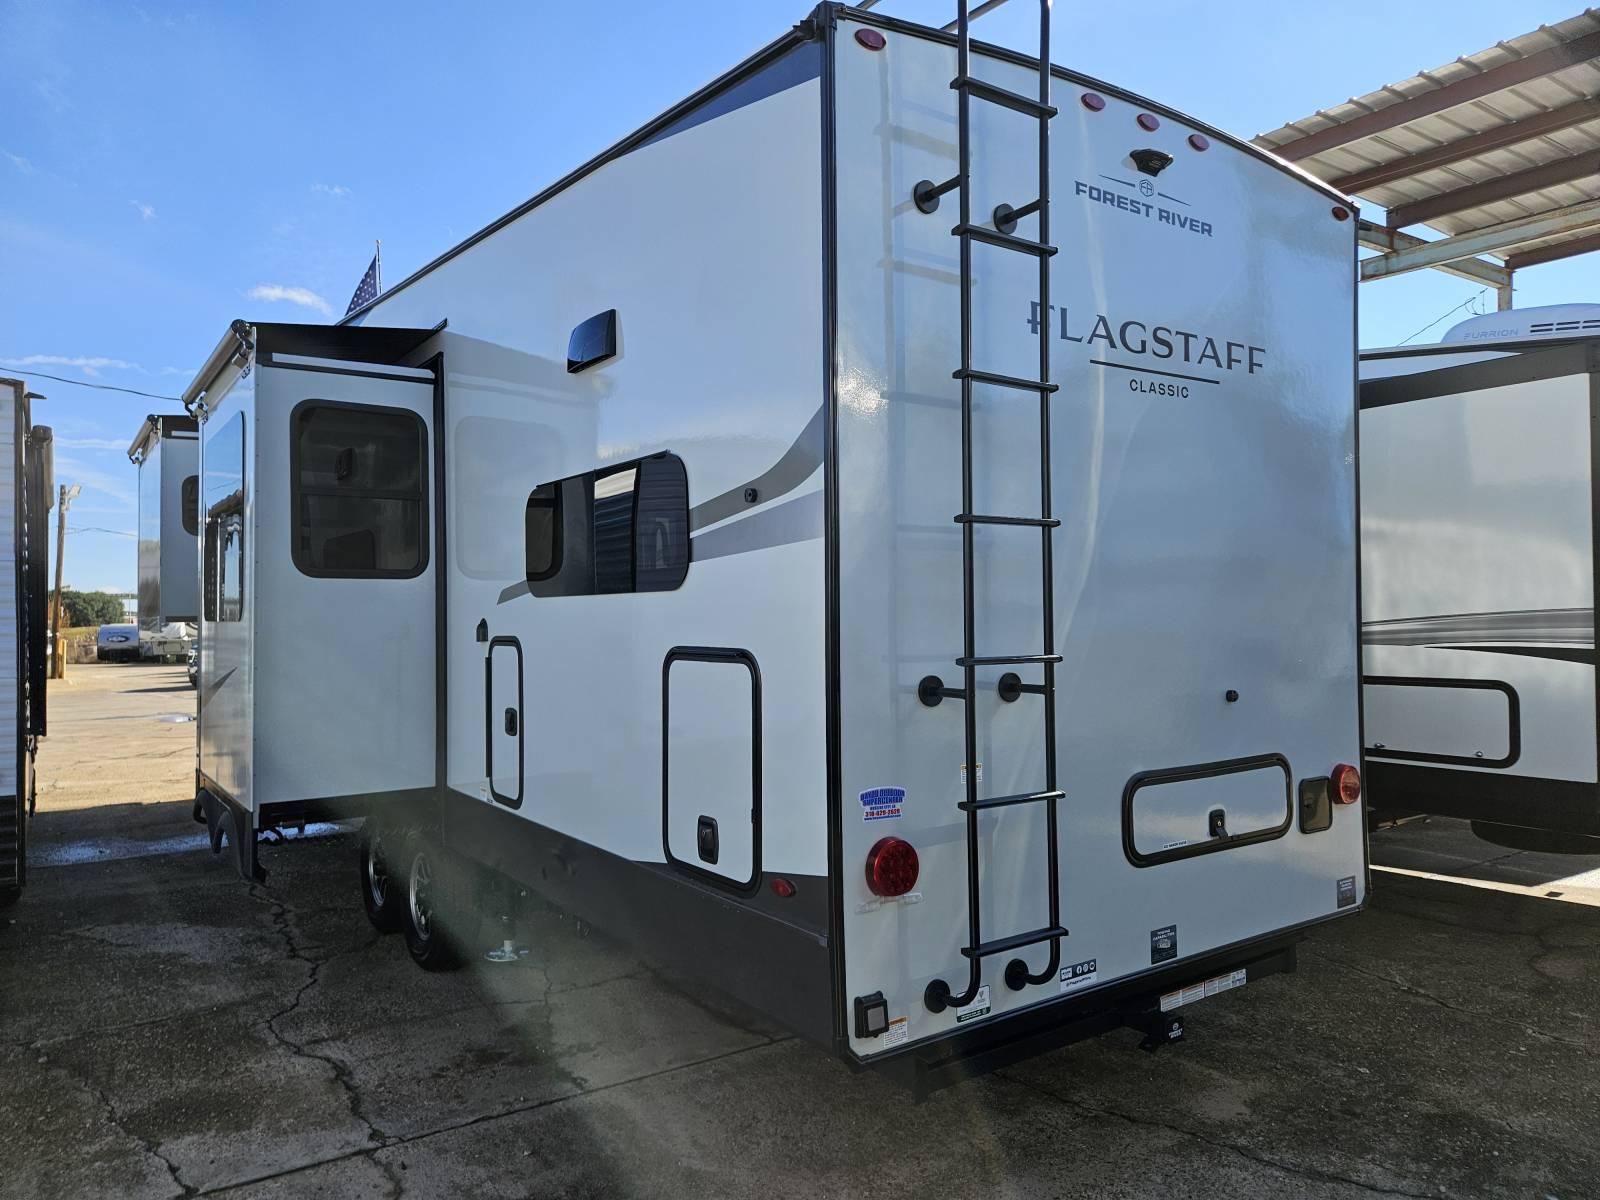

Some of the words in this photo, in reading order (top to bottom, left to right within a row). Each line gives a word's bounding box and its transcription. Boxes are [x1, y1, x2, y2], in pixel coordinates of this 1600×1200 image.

[1074, 180, 1154, 218] FOREST
[1157, 207, 1213, 237] RIVER
[1027, 300, 1266, 374] FLAGSTAFF
[1464, 328, 1519, 341] FURRION
[1129, 378, 1189, 399] CLASSIC
